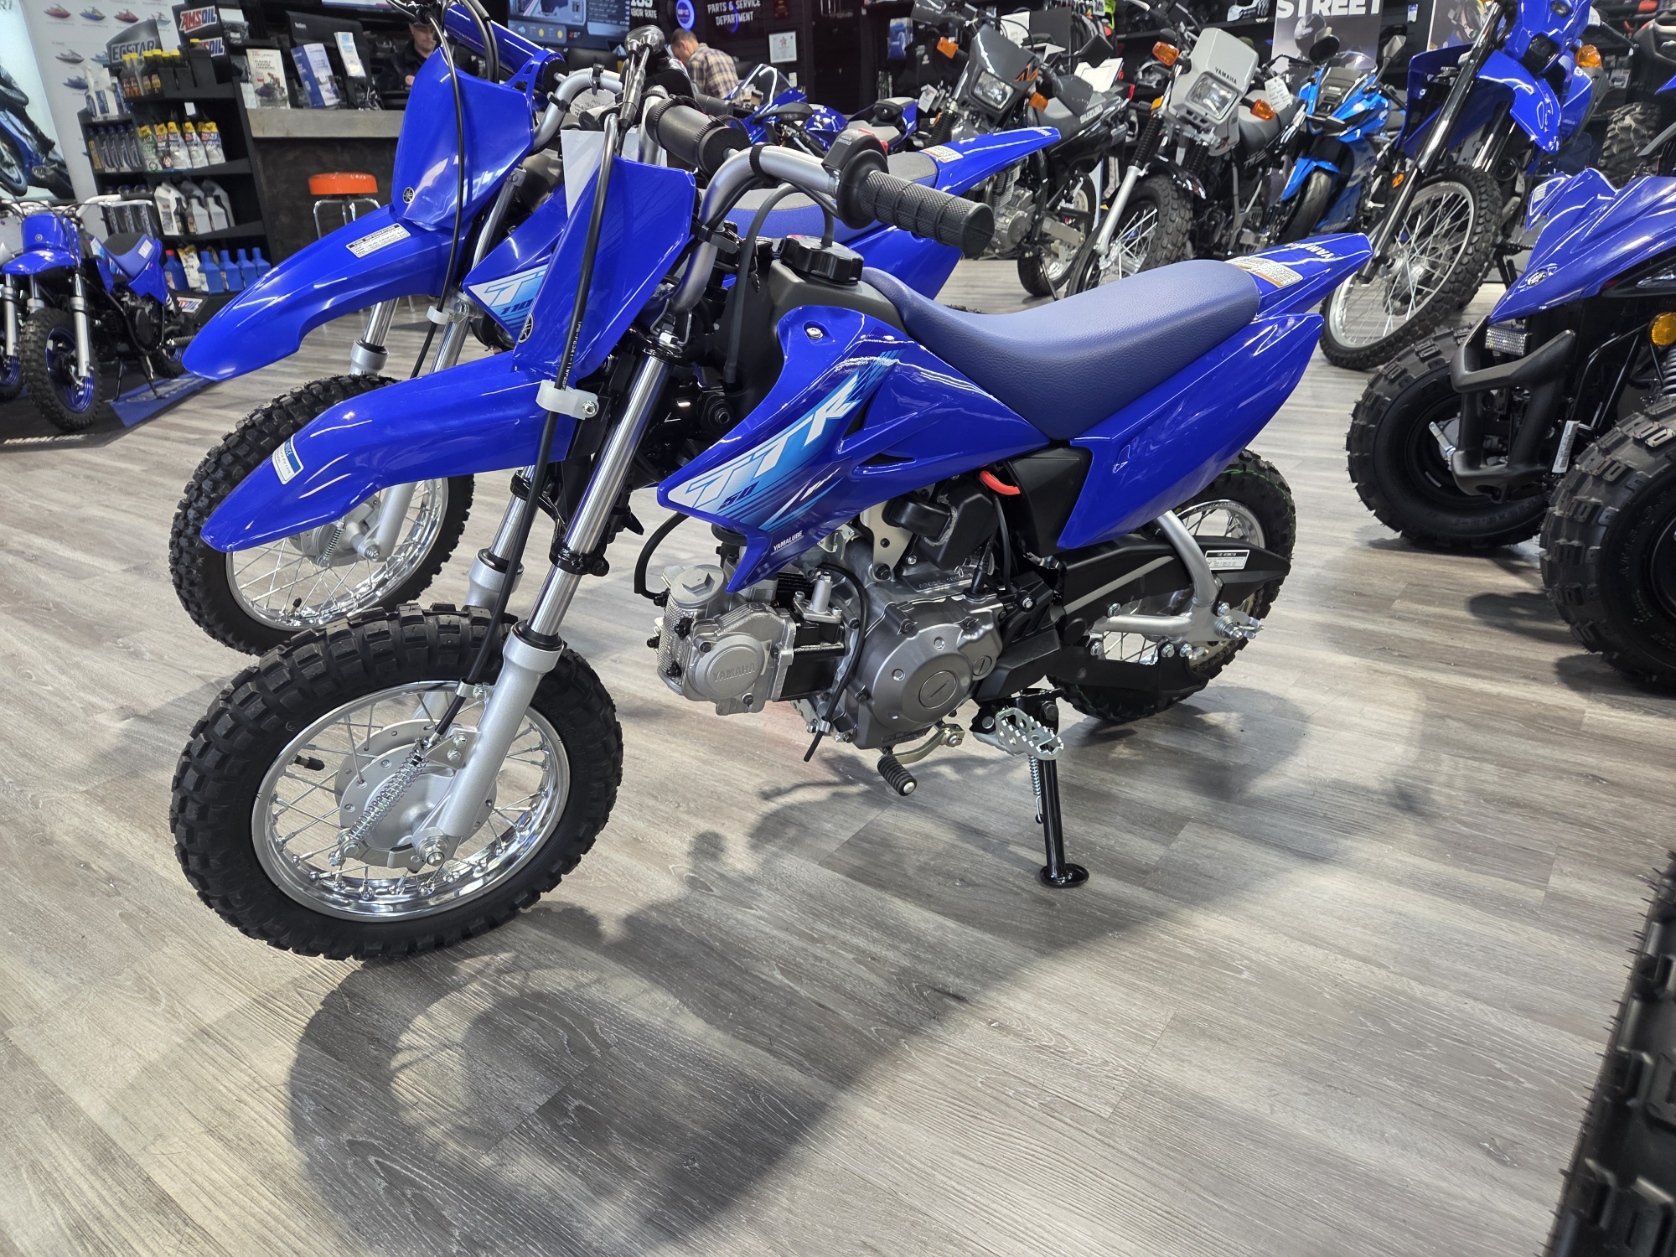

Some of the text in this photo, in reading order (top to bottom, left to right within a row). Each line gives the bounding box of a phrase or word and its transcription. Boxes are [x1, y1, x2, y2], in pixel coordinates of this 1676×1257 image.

[707, 0, 761, 14] PARTS & SERVICE
[180, 7, 217, 32] AMSOIL
[715, 11, 754, 26] DEPARTMENT
[1214, 66, 1237, 85] YAMAHA
[717, 481, 760, 511] 50
[773, 530, 804, 552] YAMALUBE
[713, 663, 756, 683] YAMAHA
